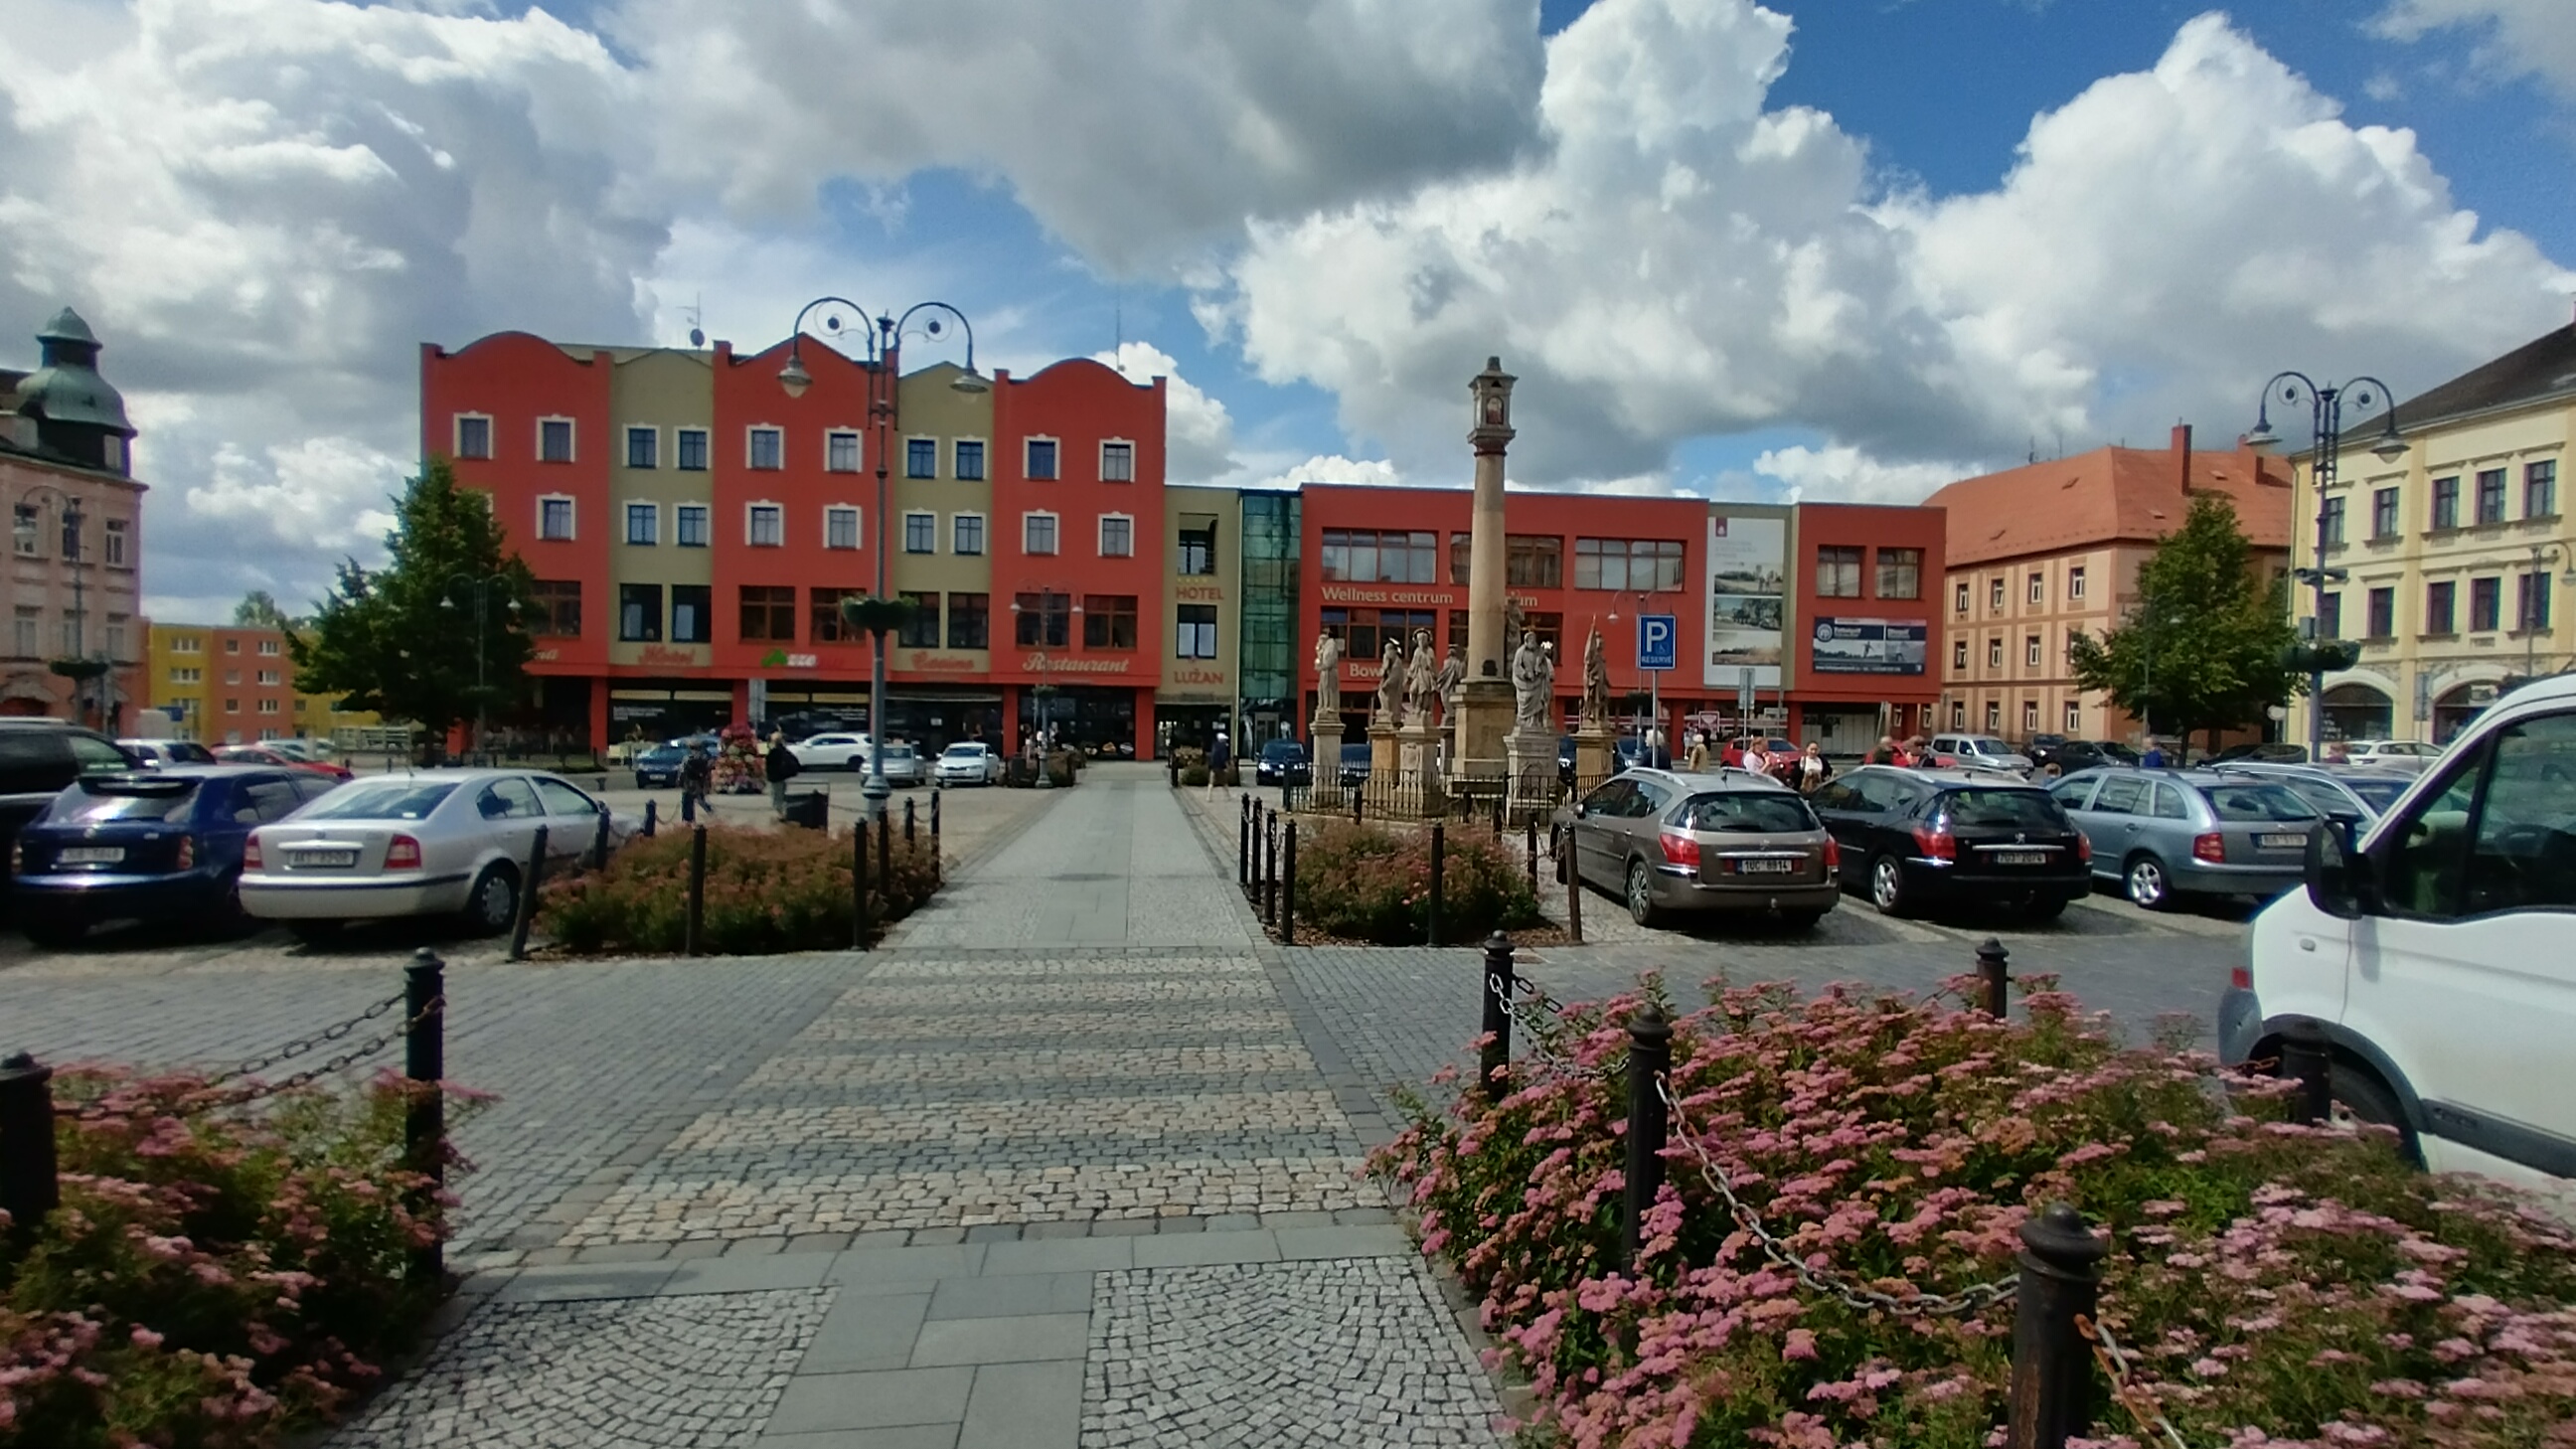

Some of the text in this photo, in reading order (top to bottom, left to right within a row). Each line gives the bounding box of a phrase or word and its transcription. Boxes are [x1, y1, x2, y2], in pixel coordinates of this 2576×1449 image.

[1176, 586, 1223, 599] HOTEL
[1321, 586, 1454, 603] Wellness centrum
[1647, 621, 1668, 652] P
[1023, 652, 1129, 672] Restaurant
[1175, 669, 1223, 684] LUŽAN
